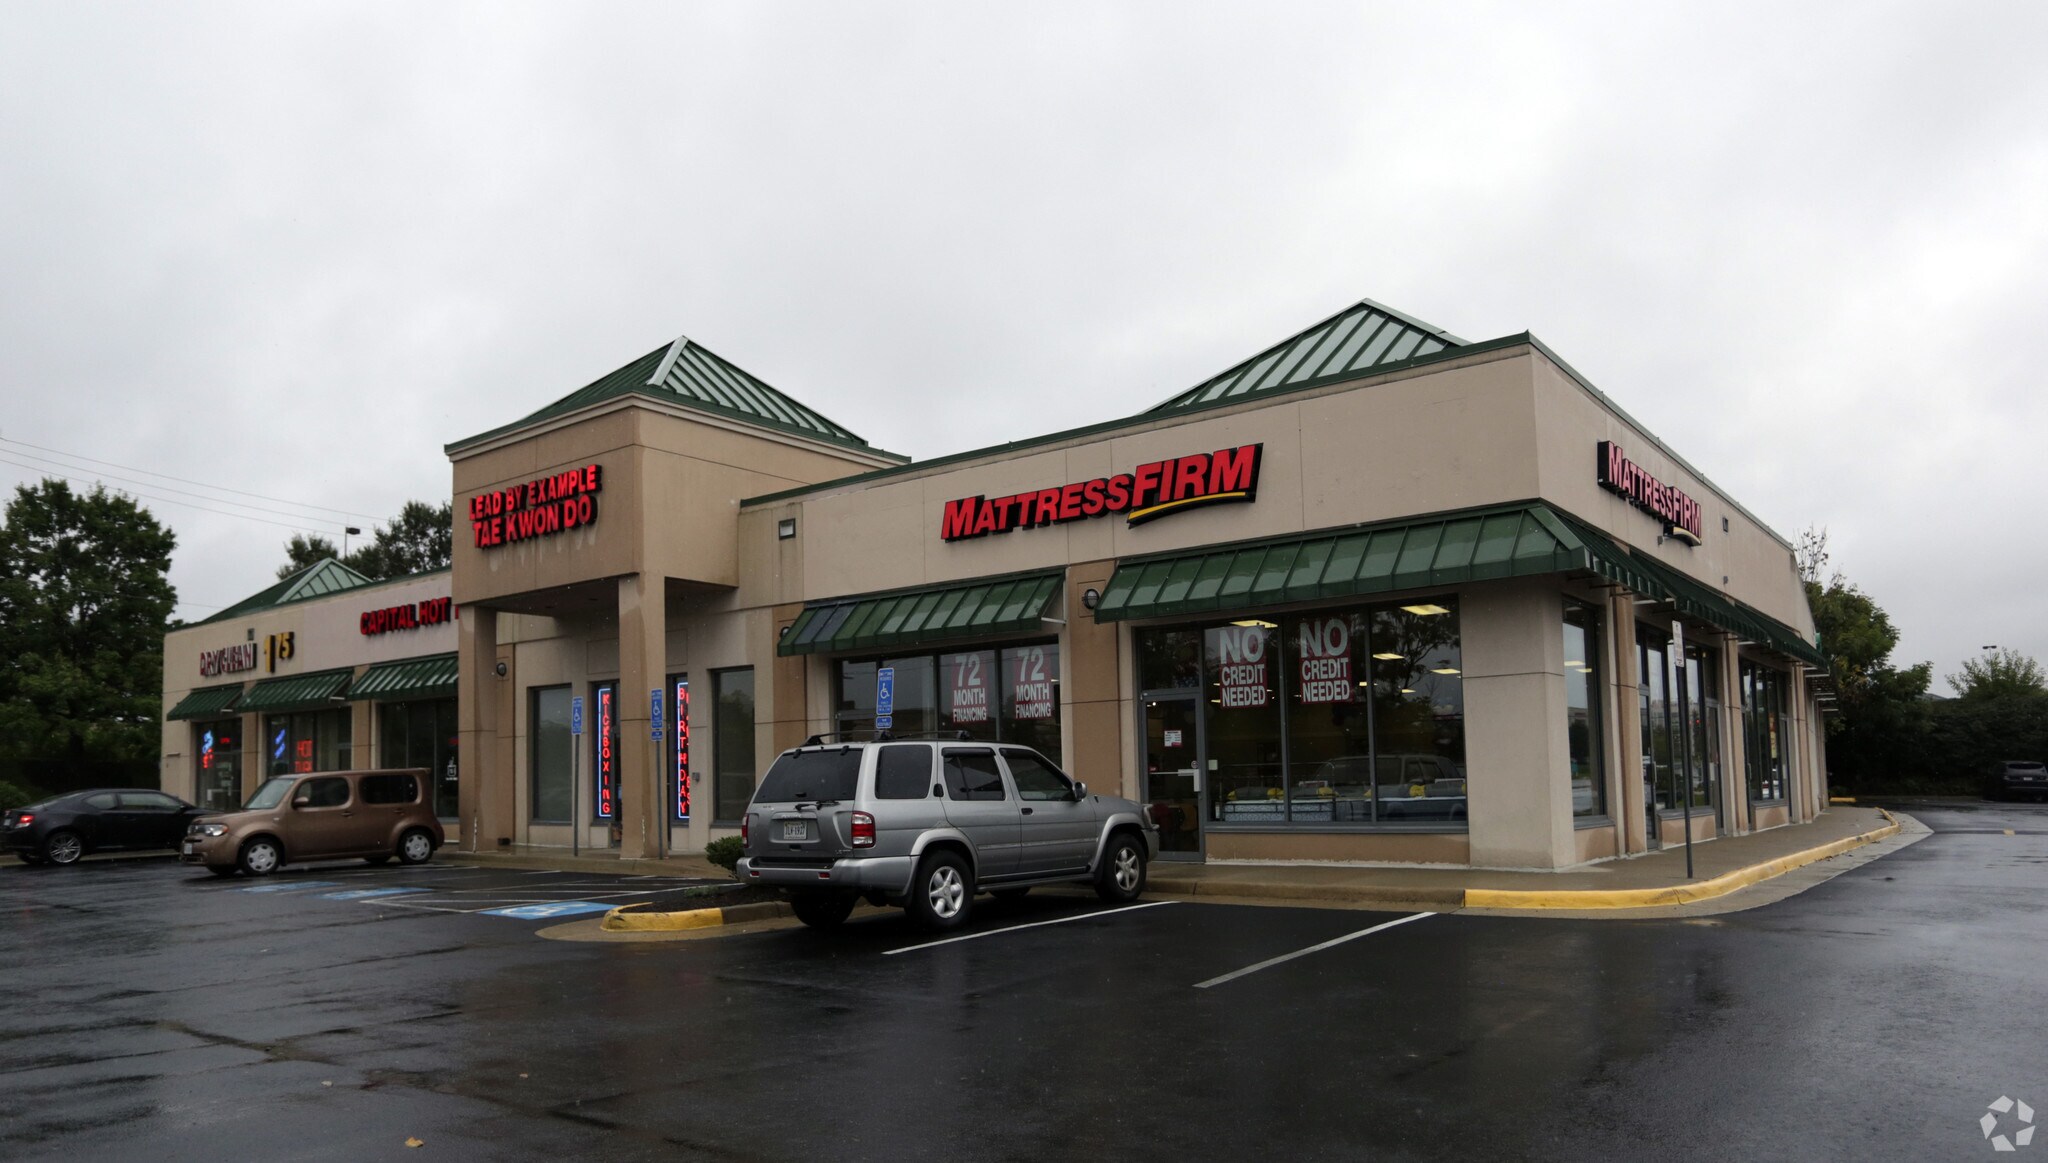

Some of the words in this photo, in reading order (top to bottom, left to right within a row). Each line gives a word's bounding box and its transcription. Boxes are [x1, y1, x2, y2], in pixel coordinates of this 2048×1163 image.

[469, 490, 503, 521] LEAD
[505, 485, 524, 512] BY
[528, 463, 598, 506] EXAMPLE
[472, 516, 502, 548] TAE
[505, 502, 559, 542] KWON
[563, 493, 592, 529] DO
[360, 604, 416, 636] CAPITAL
[418, 596, 449, 626] HOT
[1220, 626, 1265, 665] NO
[1300, 618, 1349, 658] NO
[200, 649, 221, 676] DRY
[221, 641, 255, 673] CLEAN
[954, 653, 981, 688] 72
[1017, 647, 1045, 682] 72
[1221, 663, 1265, 686] CREDIT
[1301, 657, 1349, 681] CREDIT
[953, 687, 986, 706] MONTH
[1016, 682, 1050, 702] MONTH
[1222, 685, 1266, 707] NEEDED
[1302, 679, 1350, 703] NEEDED
[952, 706, 987, 723] FINANCING
[1015, 702, 1052, 719] FINANCING
[602, 693, 611, 814] KICKBOXING
[679, 687, 687, 814] BIRTHDAY
